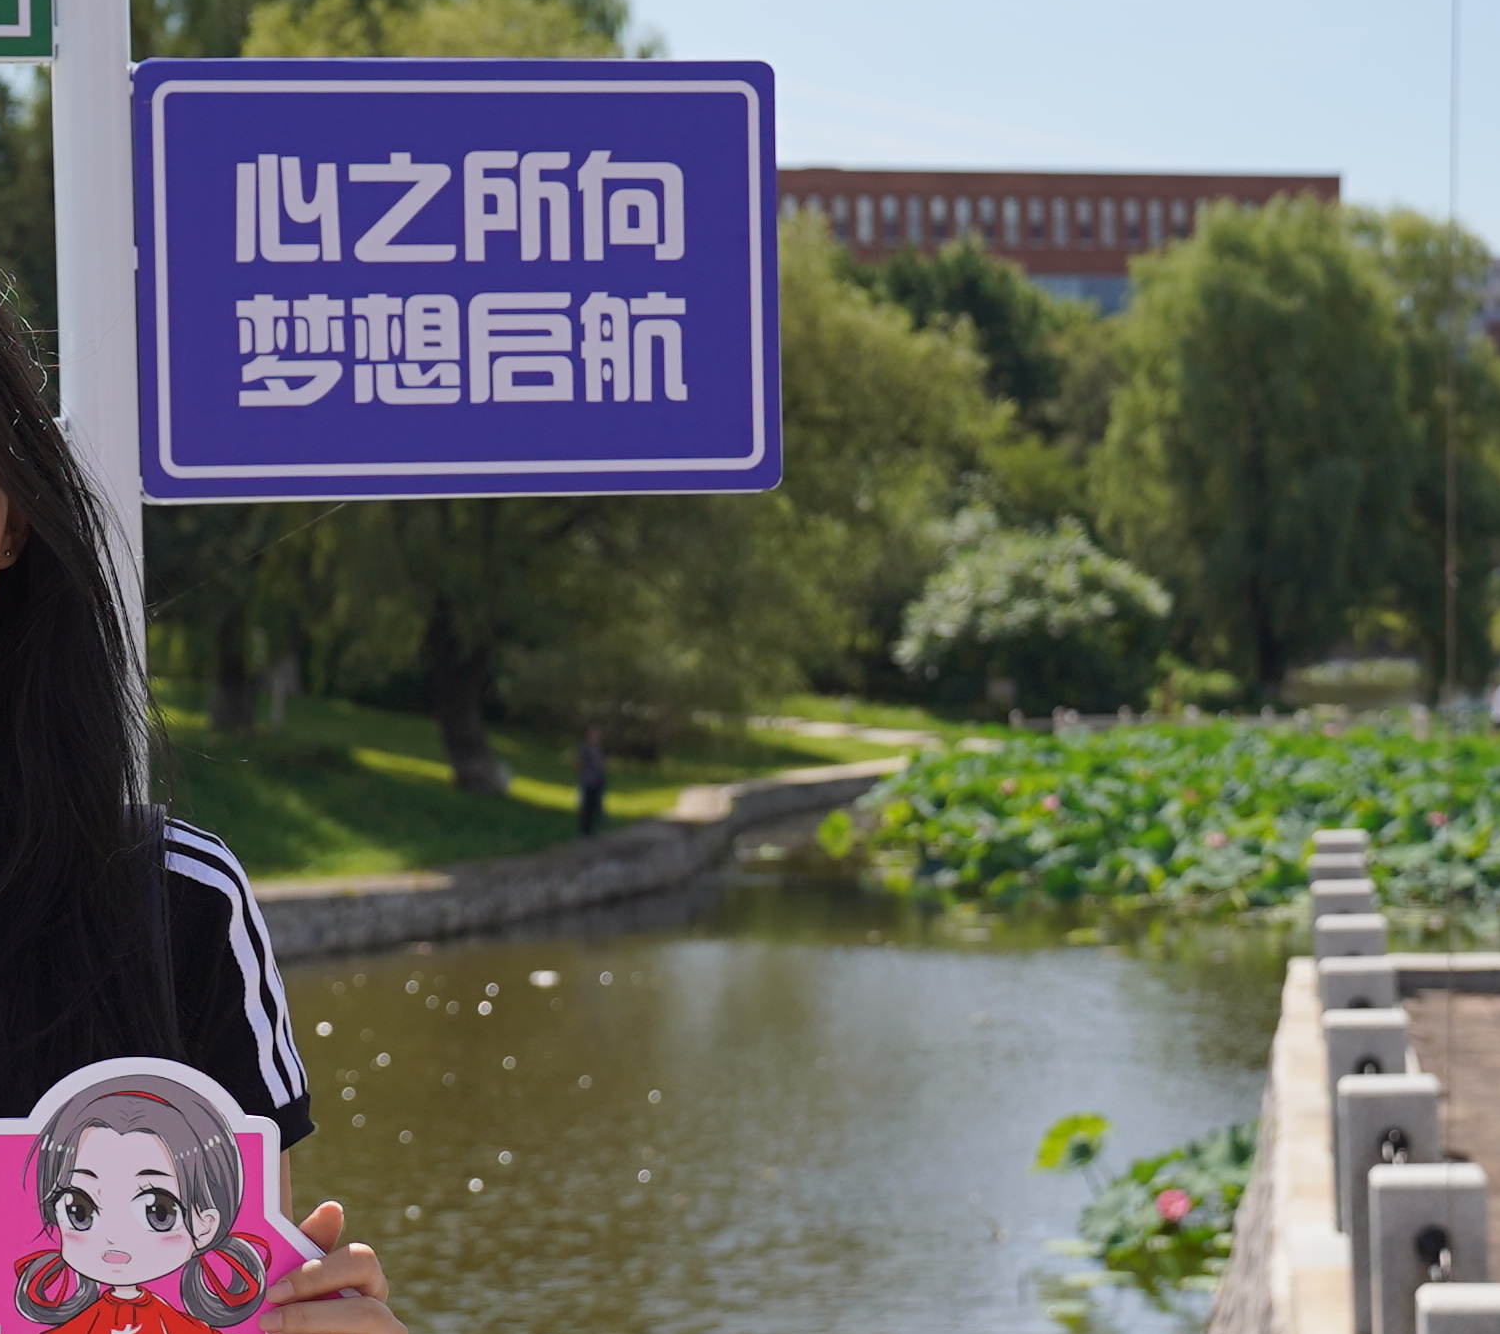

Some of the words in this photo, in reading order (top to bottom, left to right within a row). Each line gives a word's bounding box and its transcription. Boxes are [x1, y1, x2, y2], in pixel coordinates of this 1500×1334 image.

[235, 149, 686, 263] 心之所向
[235, 291, 689, 408] 梦想启航
